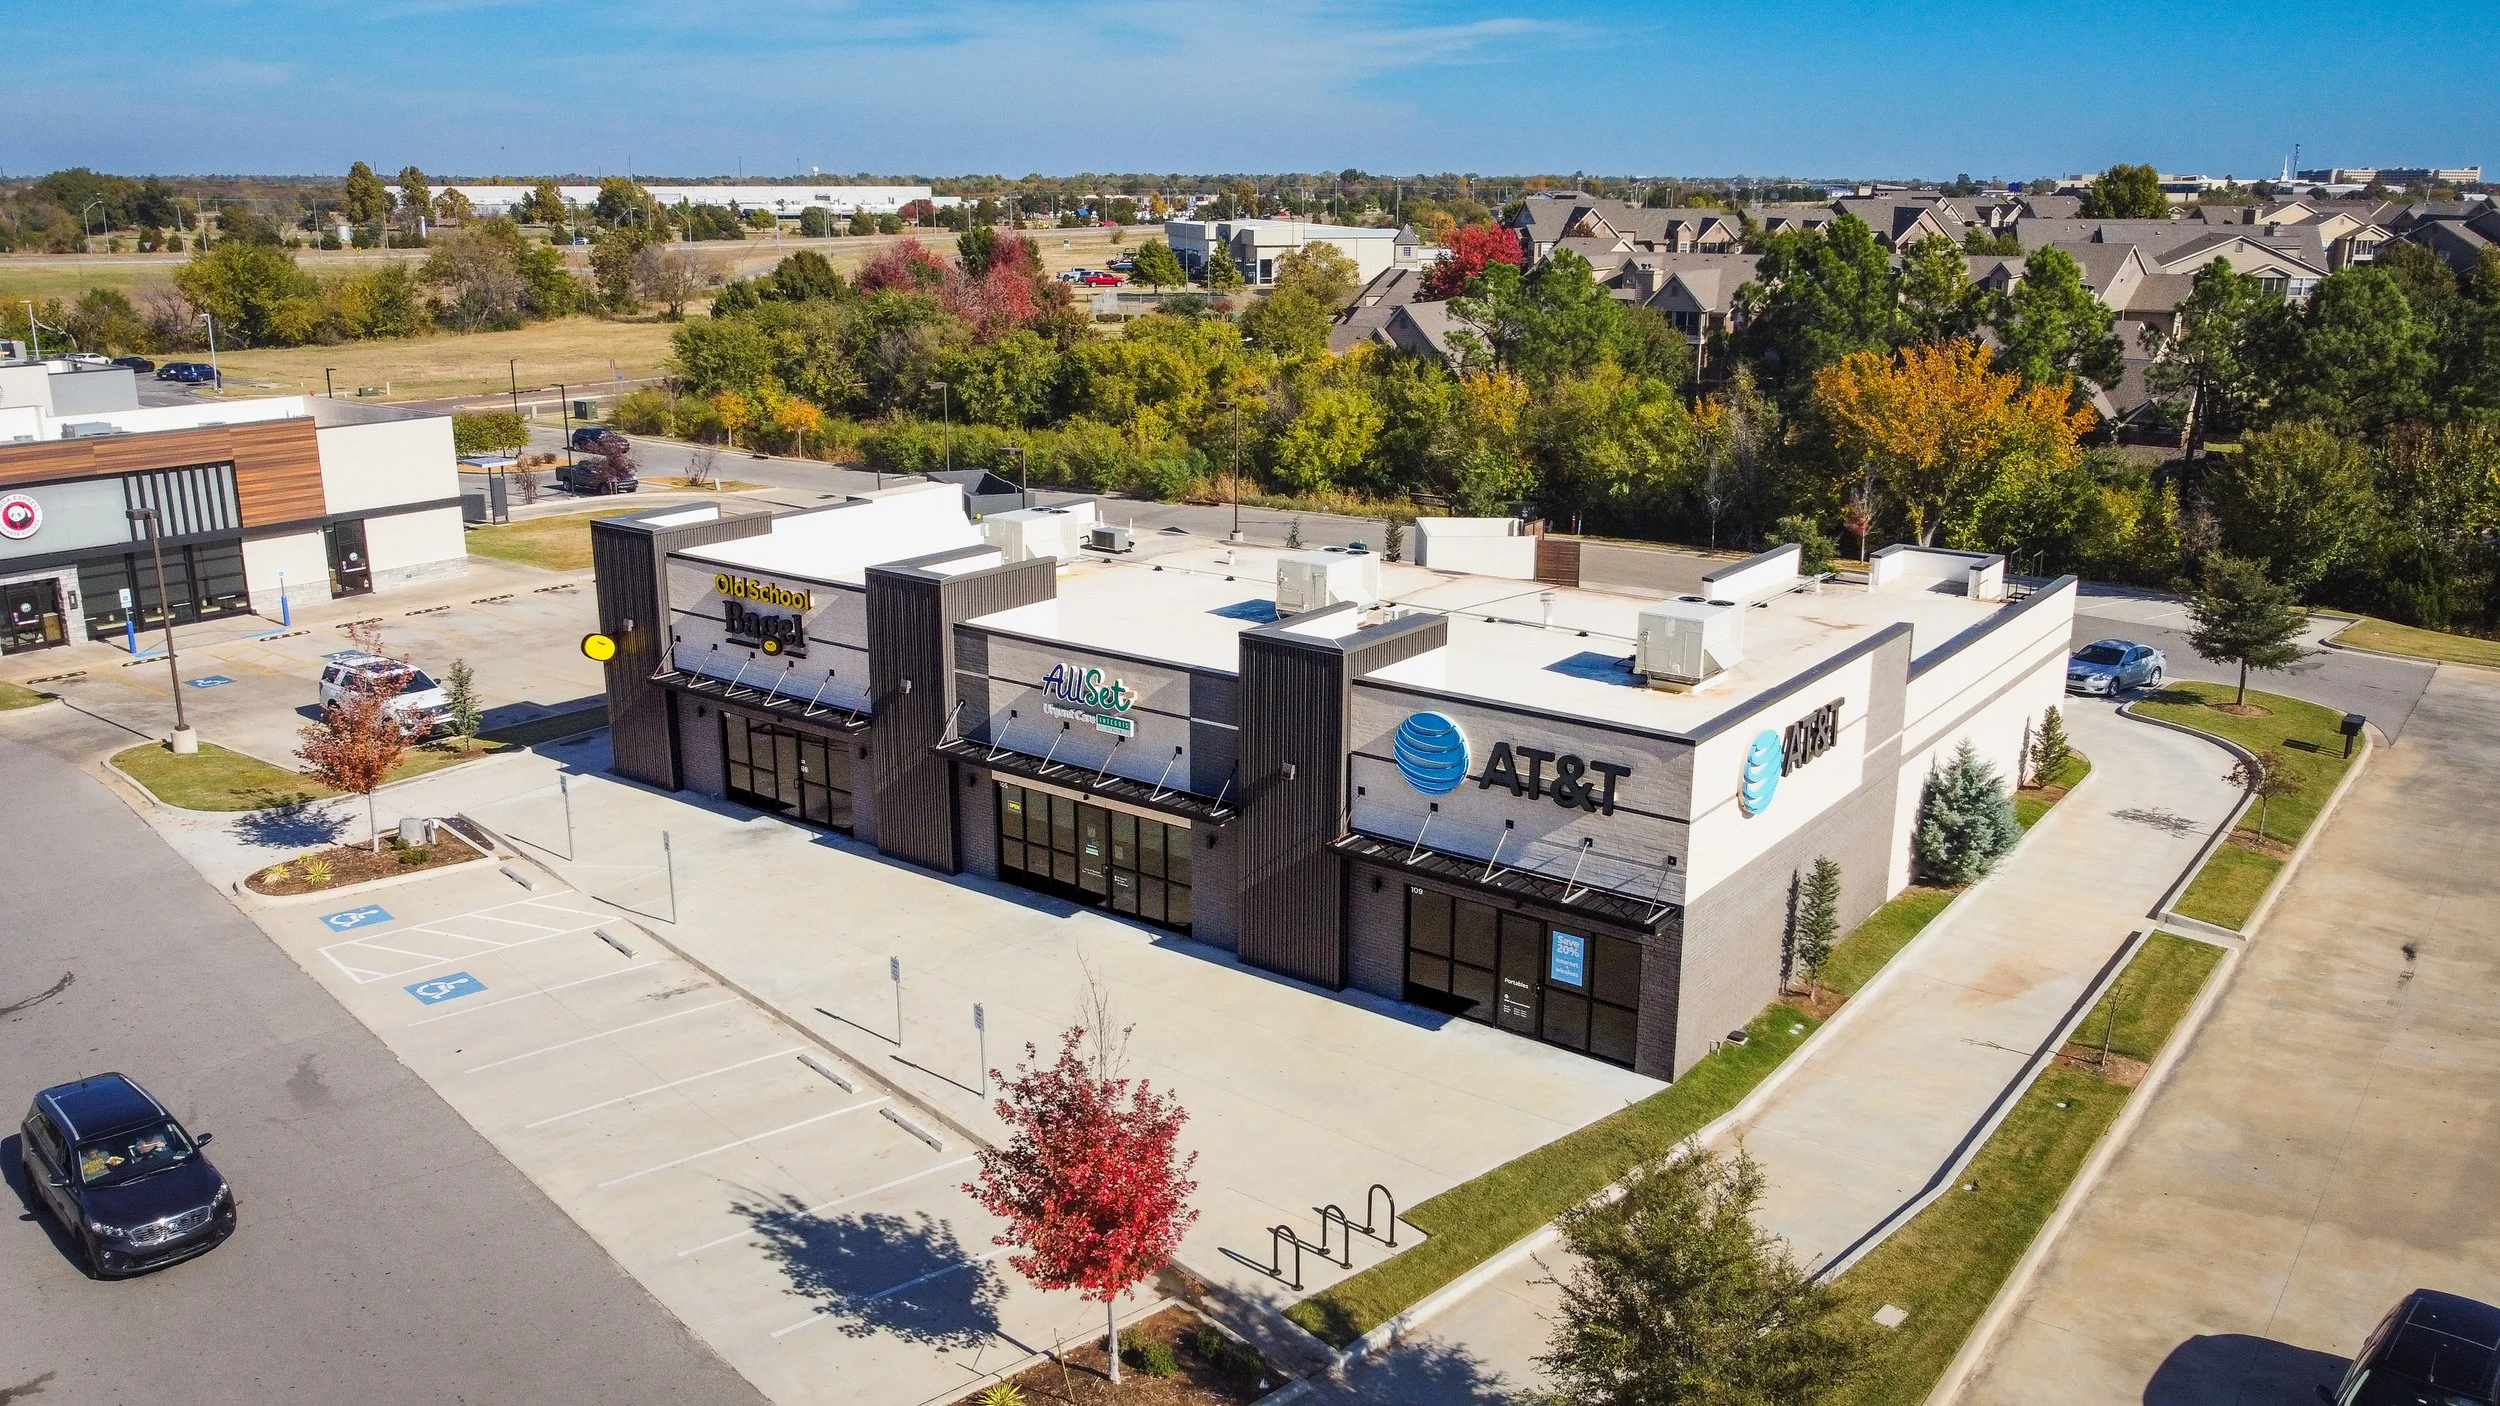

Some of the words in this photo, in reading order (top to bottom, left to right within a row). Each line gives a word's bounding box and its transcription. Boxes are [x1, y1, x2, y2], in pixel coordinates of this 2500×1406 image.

[714, 573, 748, 598] Old
[748, 579, 813, 611] School
[722, 600, 806, 650] Bagel
[1042, 663, 1135, 712] AllSet
[1043, 702, 1075, 719] Urgent
[1074, 709, 1096, 724] Care
[1781, 696, 1845, 777] AT&T
[1478, 741, 1632, 817] AT&T
[1410, 886, 1424, 895] 109
[1557, 934, 1580, 948] Save
[1557, 944, 1580, 958] 20%
